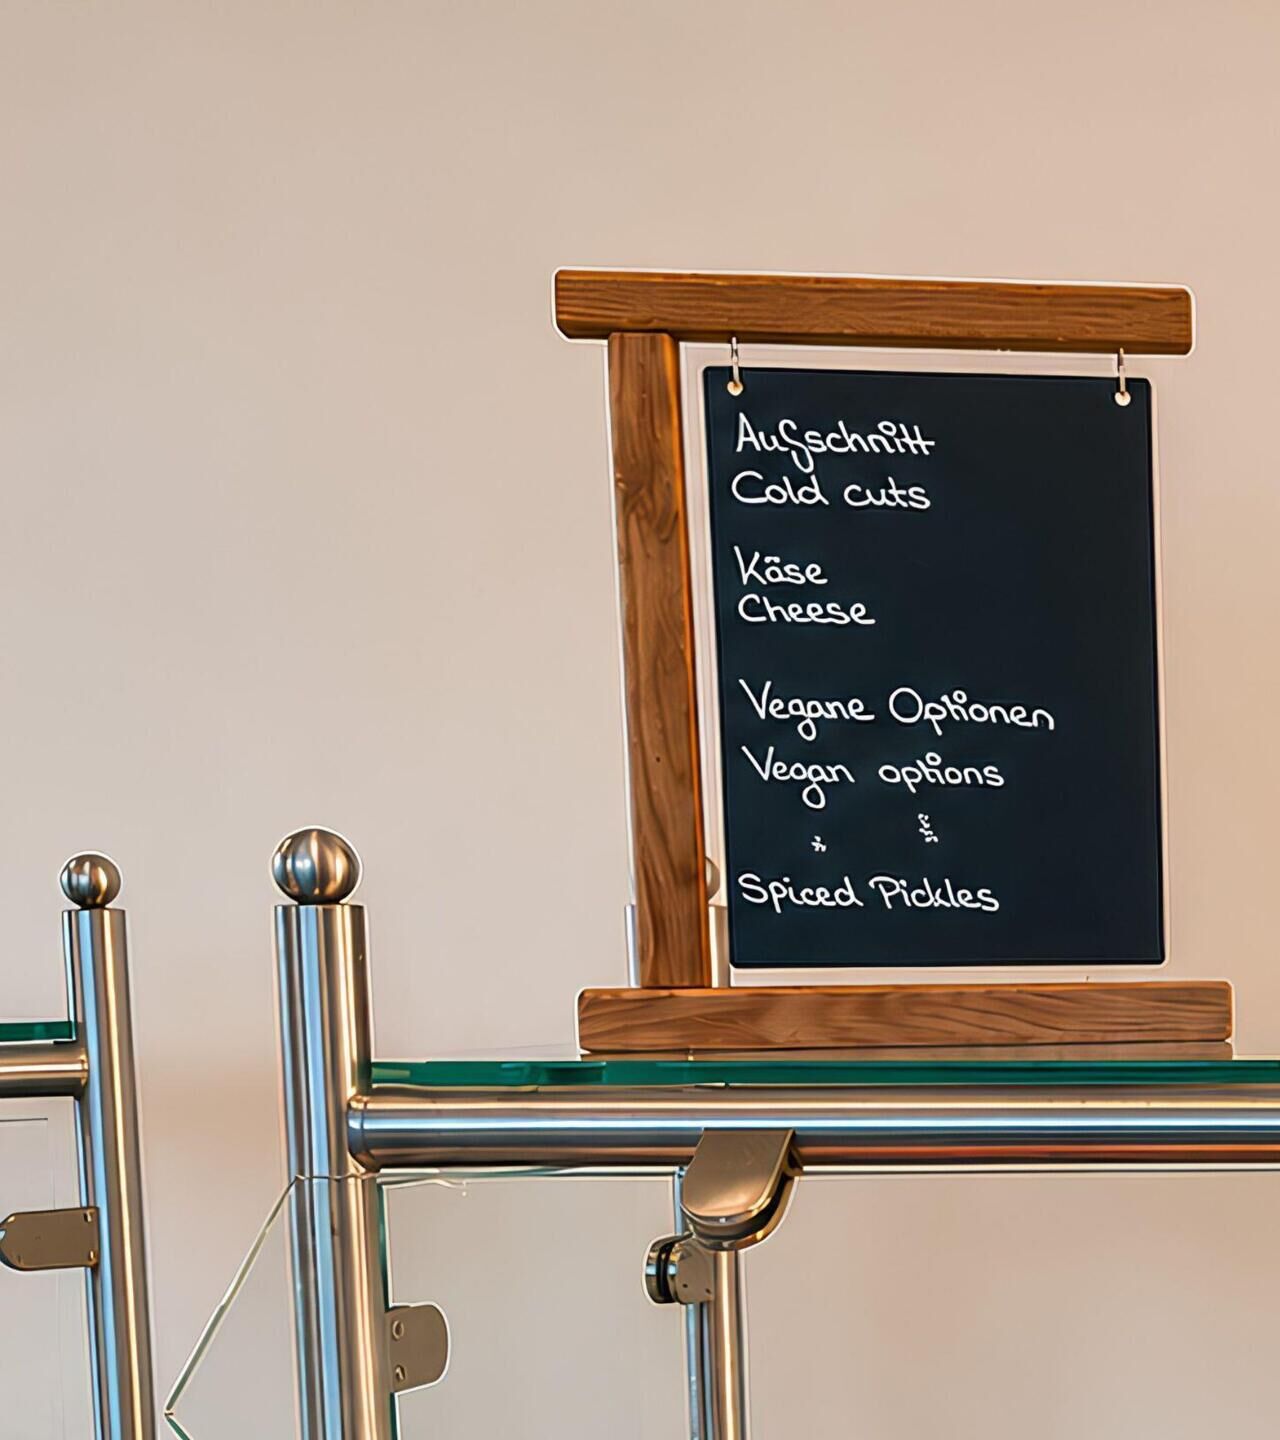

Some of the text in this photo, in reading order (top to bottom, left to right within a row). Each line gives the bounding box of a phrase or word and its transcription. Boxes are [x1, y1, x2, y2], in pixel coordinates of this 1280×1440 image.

[735, 411, 936, 474] Aufschnitt
[731, 469, 932, 511] Cold cuts
[733, 544, 829, 587] Käse
[737, 592, 877, 626] Cheese
[738, 677, 1056, 743] Vegane Optionen
[741, 744, 1006, 809] Vegan options
[737, 872, 1001, 915] Spiced Pickles
